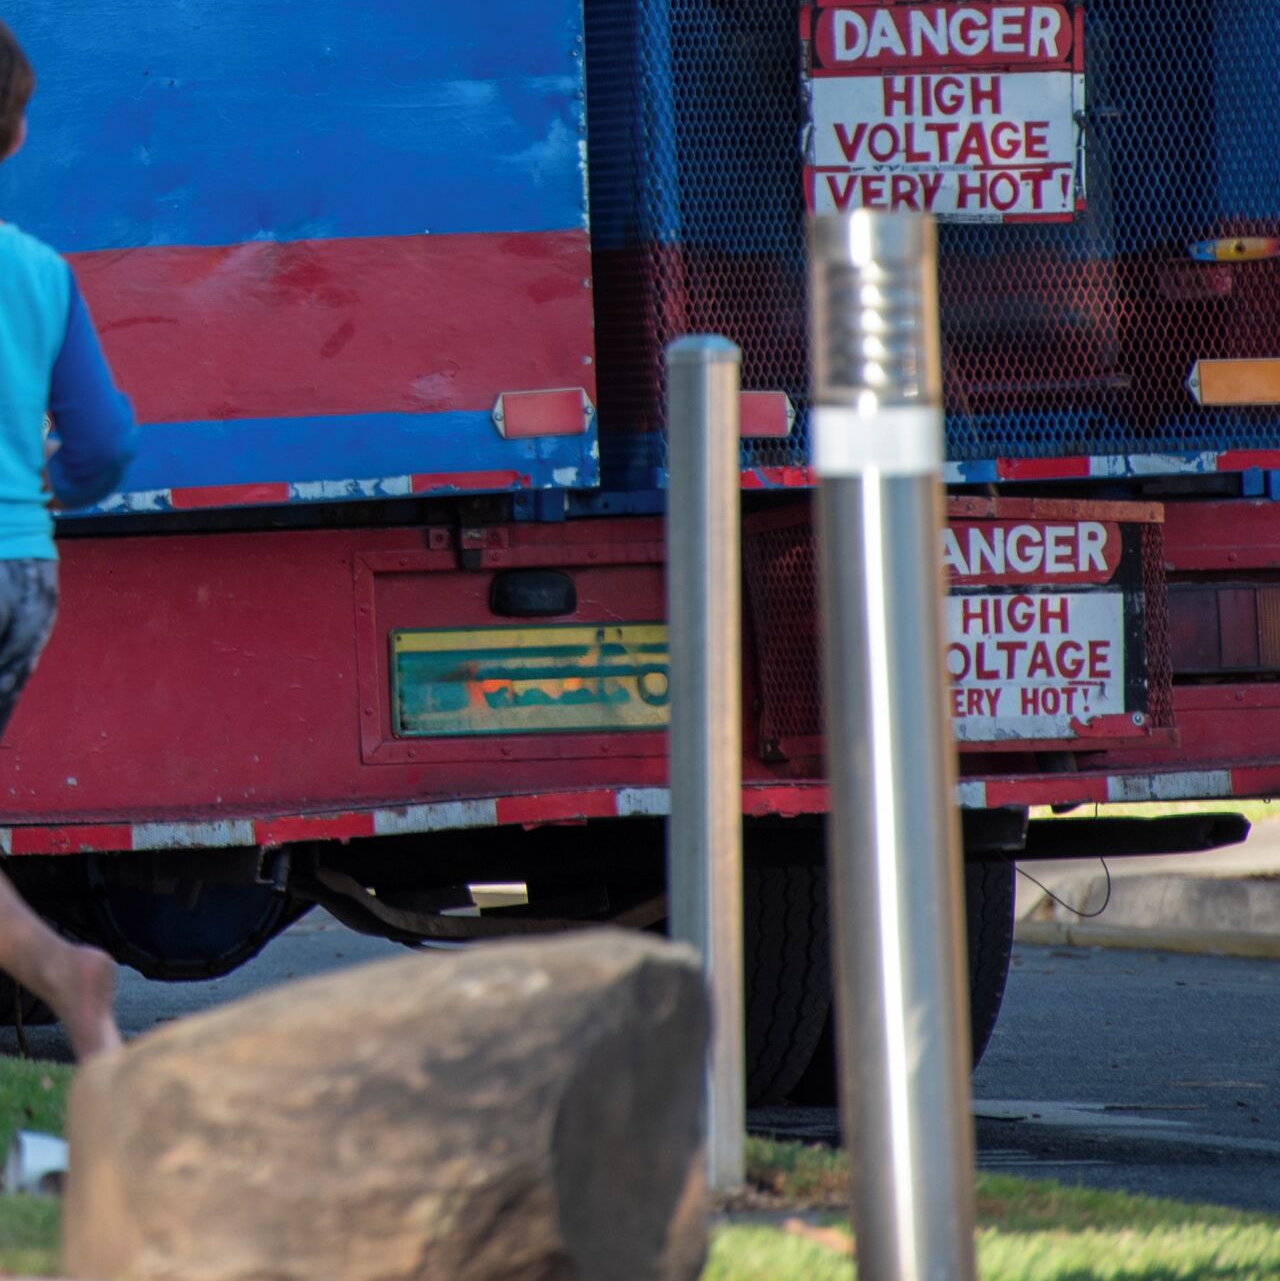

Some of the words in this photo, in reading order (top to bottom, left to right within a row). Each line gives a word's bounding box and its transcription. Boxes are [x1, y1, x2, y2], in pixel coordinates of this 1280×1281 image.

[833, 6, 1062, 61] DANGER
[882, 75, 1002, 117] HIGH
[833, 121, 1050, 165] VOLTAGE
[826, 172, 943, 213] VERY
[956, 168, 1071, 211] HOT!
[942, 522, 1110, 576] ANGER
[962, 594, 1069, 634] HIGH
[945, 639, 1112, 680] OLTAGE
[950, 687, 1002, 718] ERY
[1020, 686, 1092, 716] HOT!
